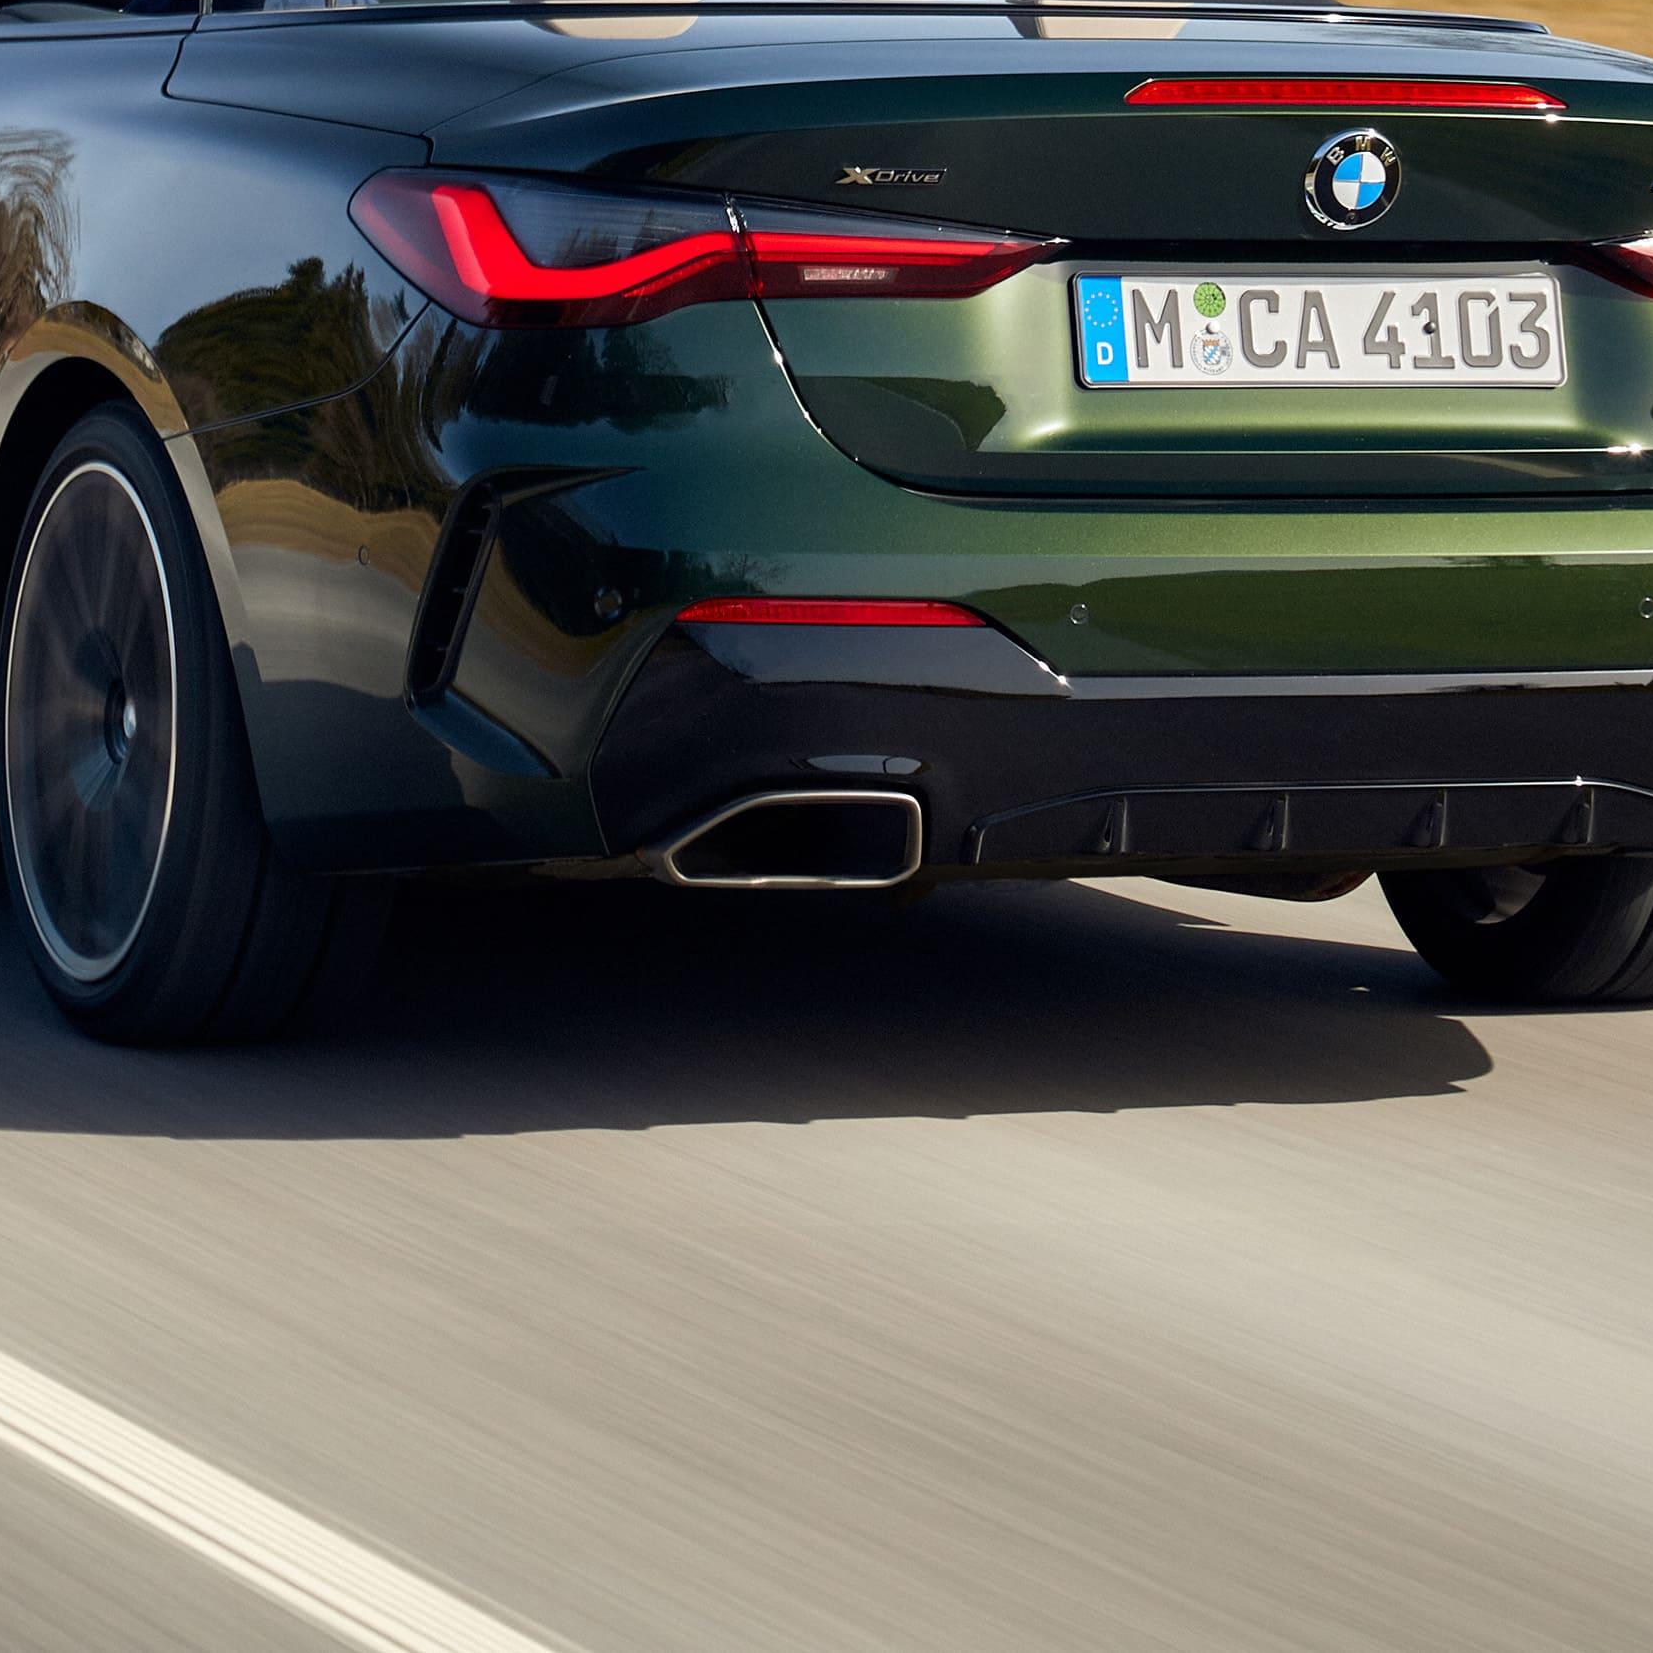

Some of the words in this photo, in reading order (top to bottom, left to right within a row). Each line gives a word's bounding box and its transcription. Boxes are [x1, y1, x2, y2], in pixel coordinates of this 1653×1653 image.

[1326, 135, 1396, 167] BMW
[1131, 289, 1184, 369] M
[1238, 289, 1341, 369] CA
[1363, 290, 1552, 370] 4103
[1097, 342, 1114, 366] D
